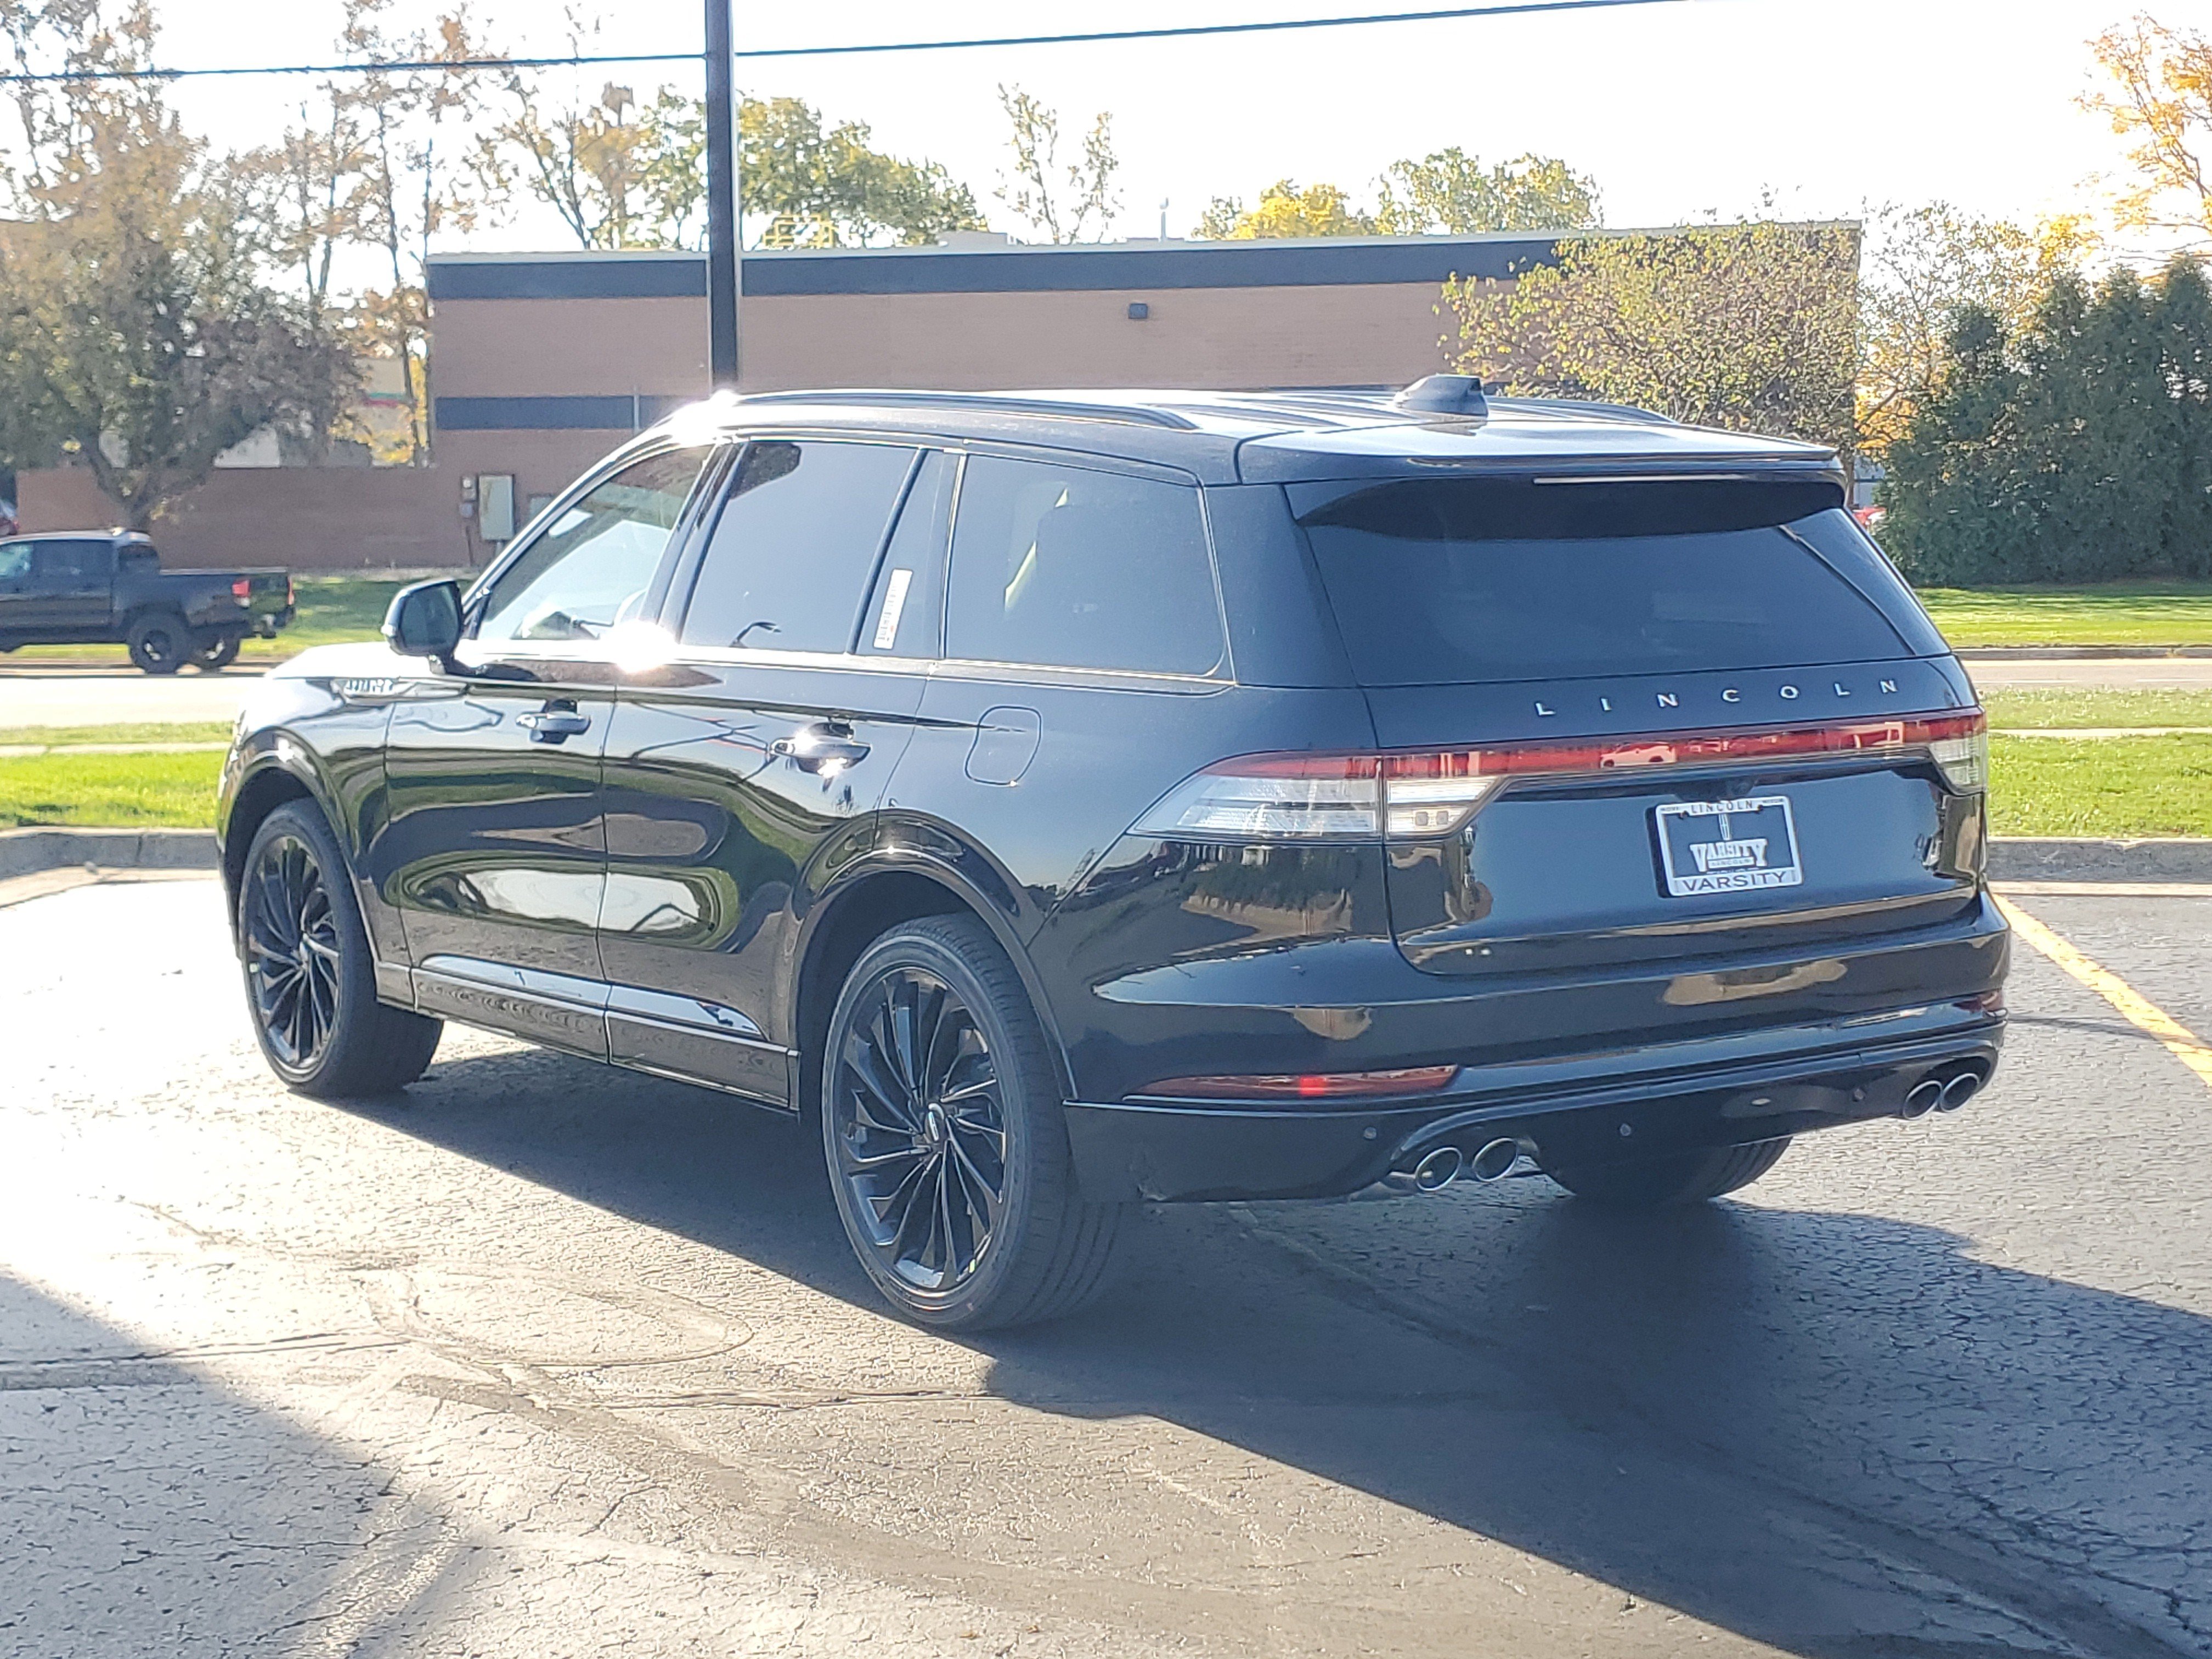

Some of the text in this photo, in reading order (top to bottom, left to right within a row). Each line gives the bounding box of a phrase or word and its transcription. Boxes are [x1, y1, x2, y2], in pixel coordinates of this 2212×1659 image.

[1535, 679, 1897, 716] LINCOLN
[1691, 800, 1753, 814] LINCOLN
[1690, 838, 1767, 872] VARSITY
[1683, 872, 1786, 891] VARSITY
